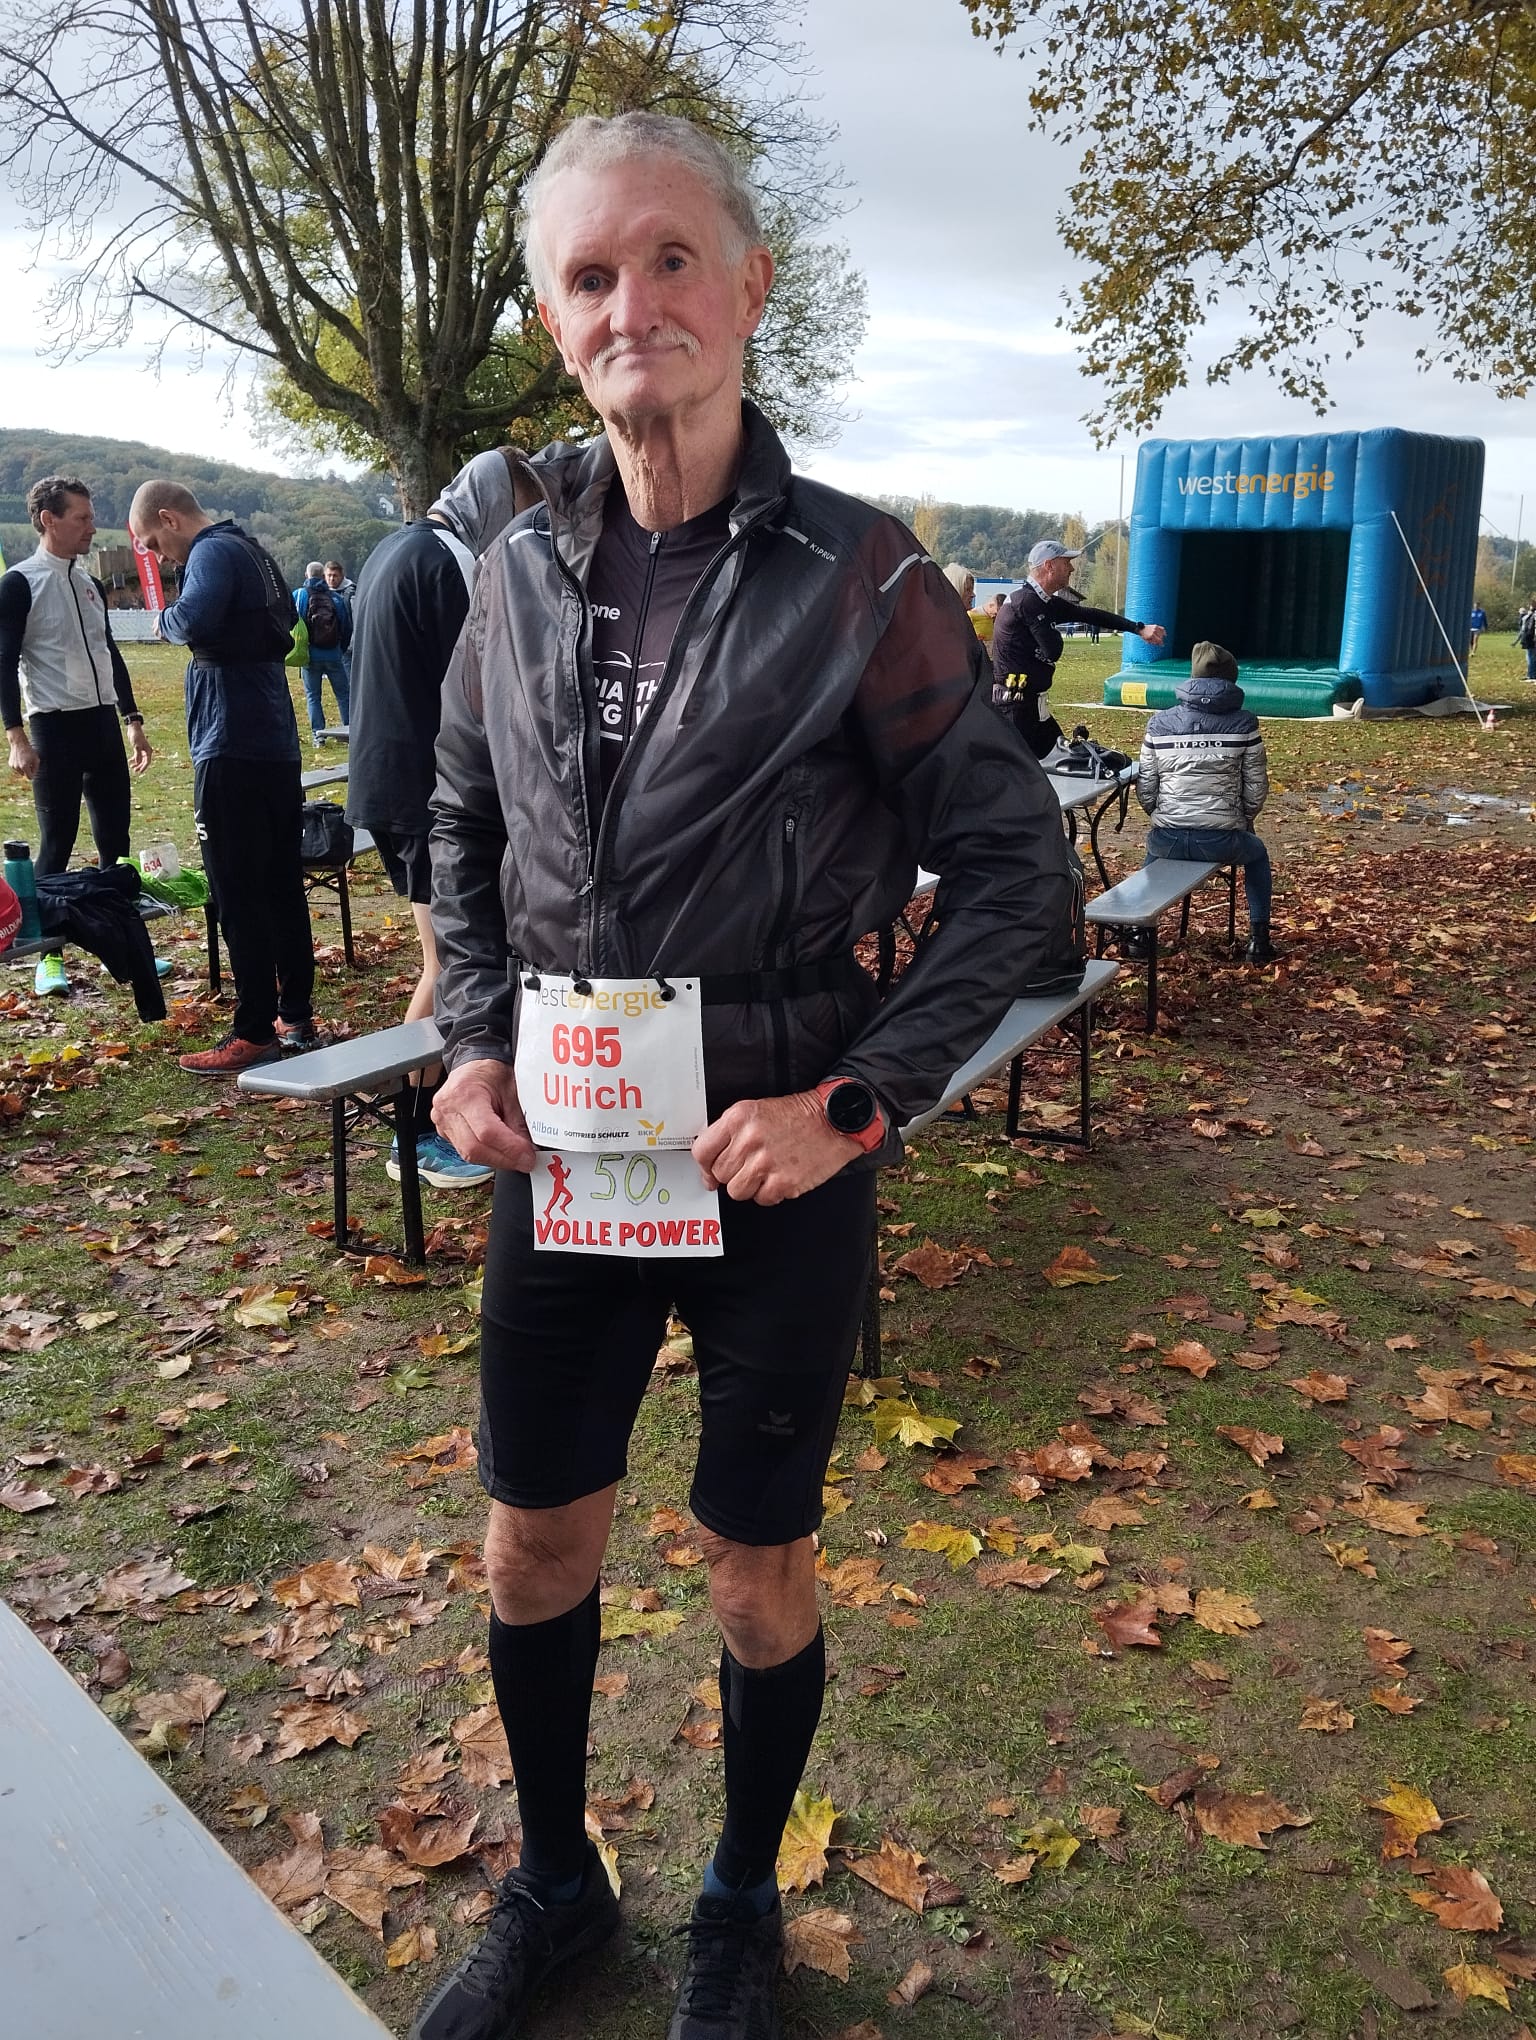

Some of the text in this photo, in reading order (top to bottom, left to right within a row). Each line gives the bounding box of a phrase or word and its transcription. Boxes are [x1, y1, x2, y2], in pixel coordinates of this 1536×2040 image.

[1177, 463, 1335, 499] westenergie
[809, 542, 837, 562] KIPRUN
[1191, 740, 1223, 748] POLO
[143, 857, 162, 872] 634
[552, 1023, 622, 1068] 695
[543, 1072, 642, 1110] Ulrich
[531, 1120, 559, 1136] Allbau
[563, 1130, 597, 1139] GOTTFRIED
[590, 1152, 670, 1206] 50.
[536, 1218, 721, 1247] VOLLE POWER
